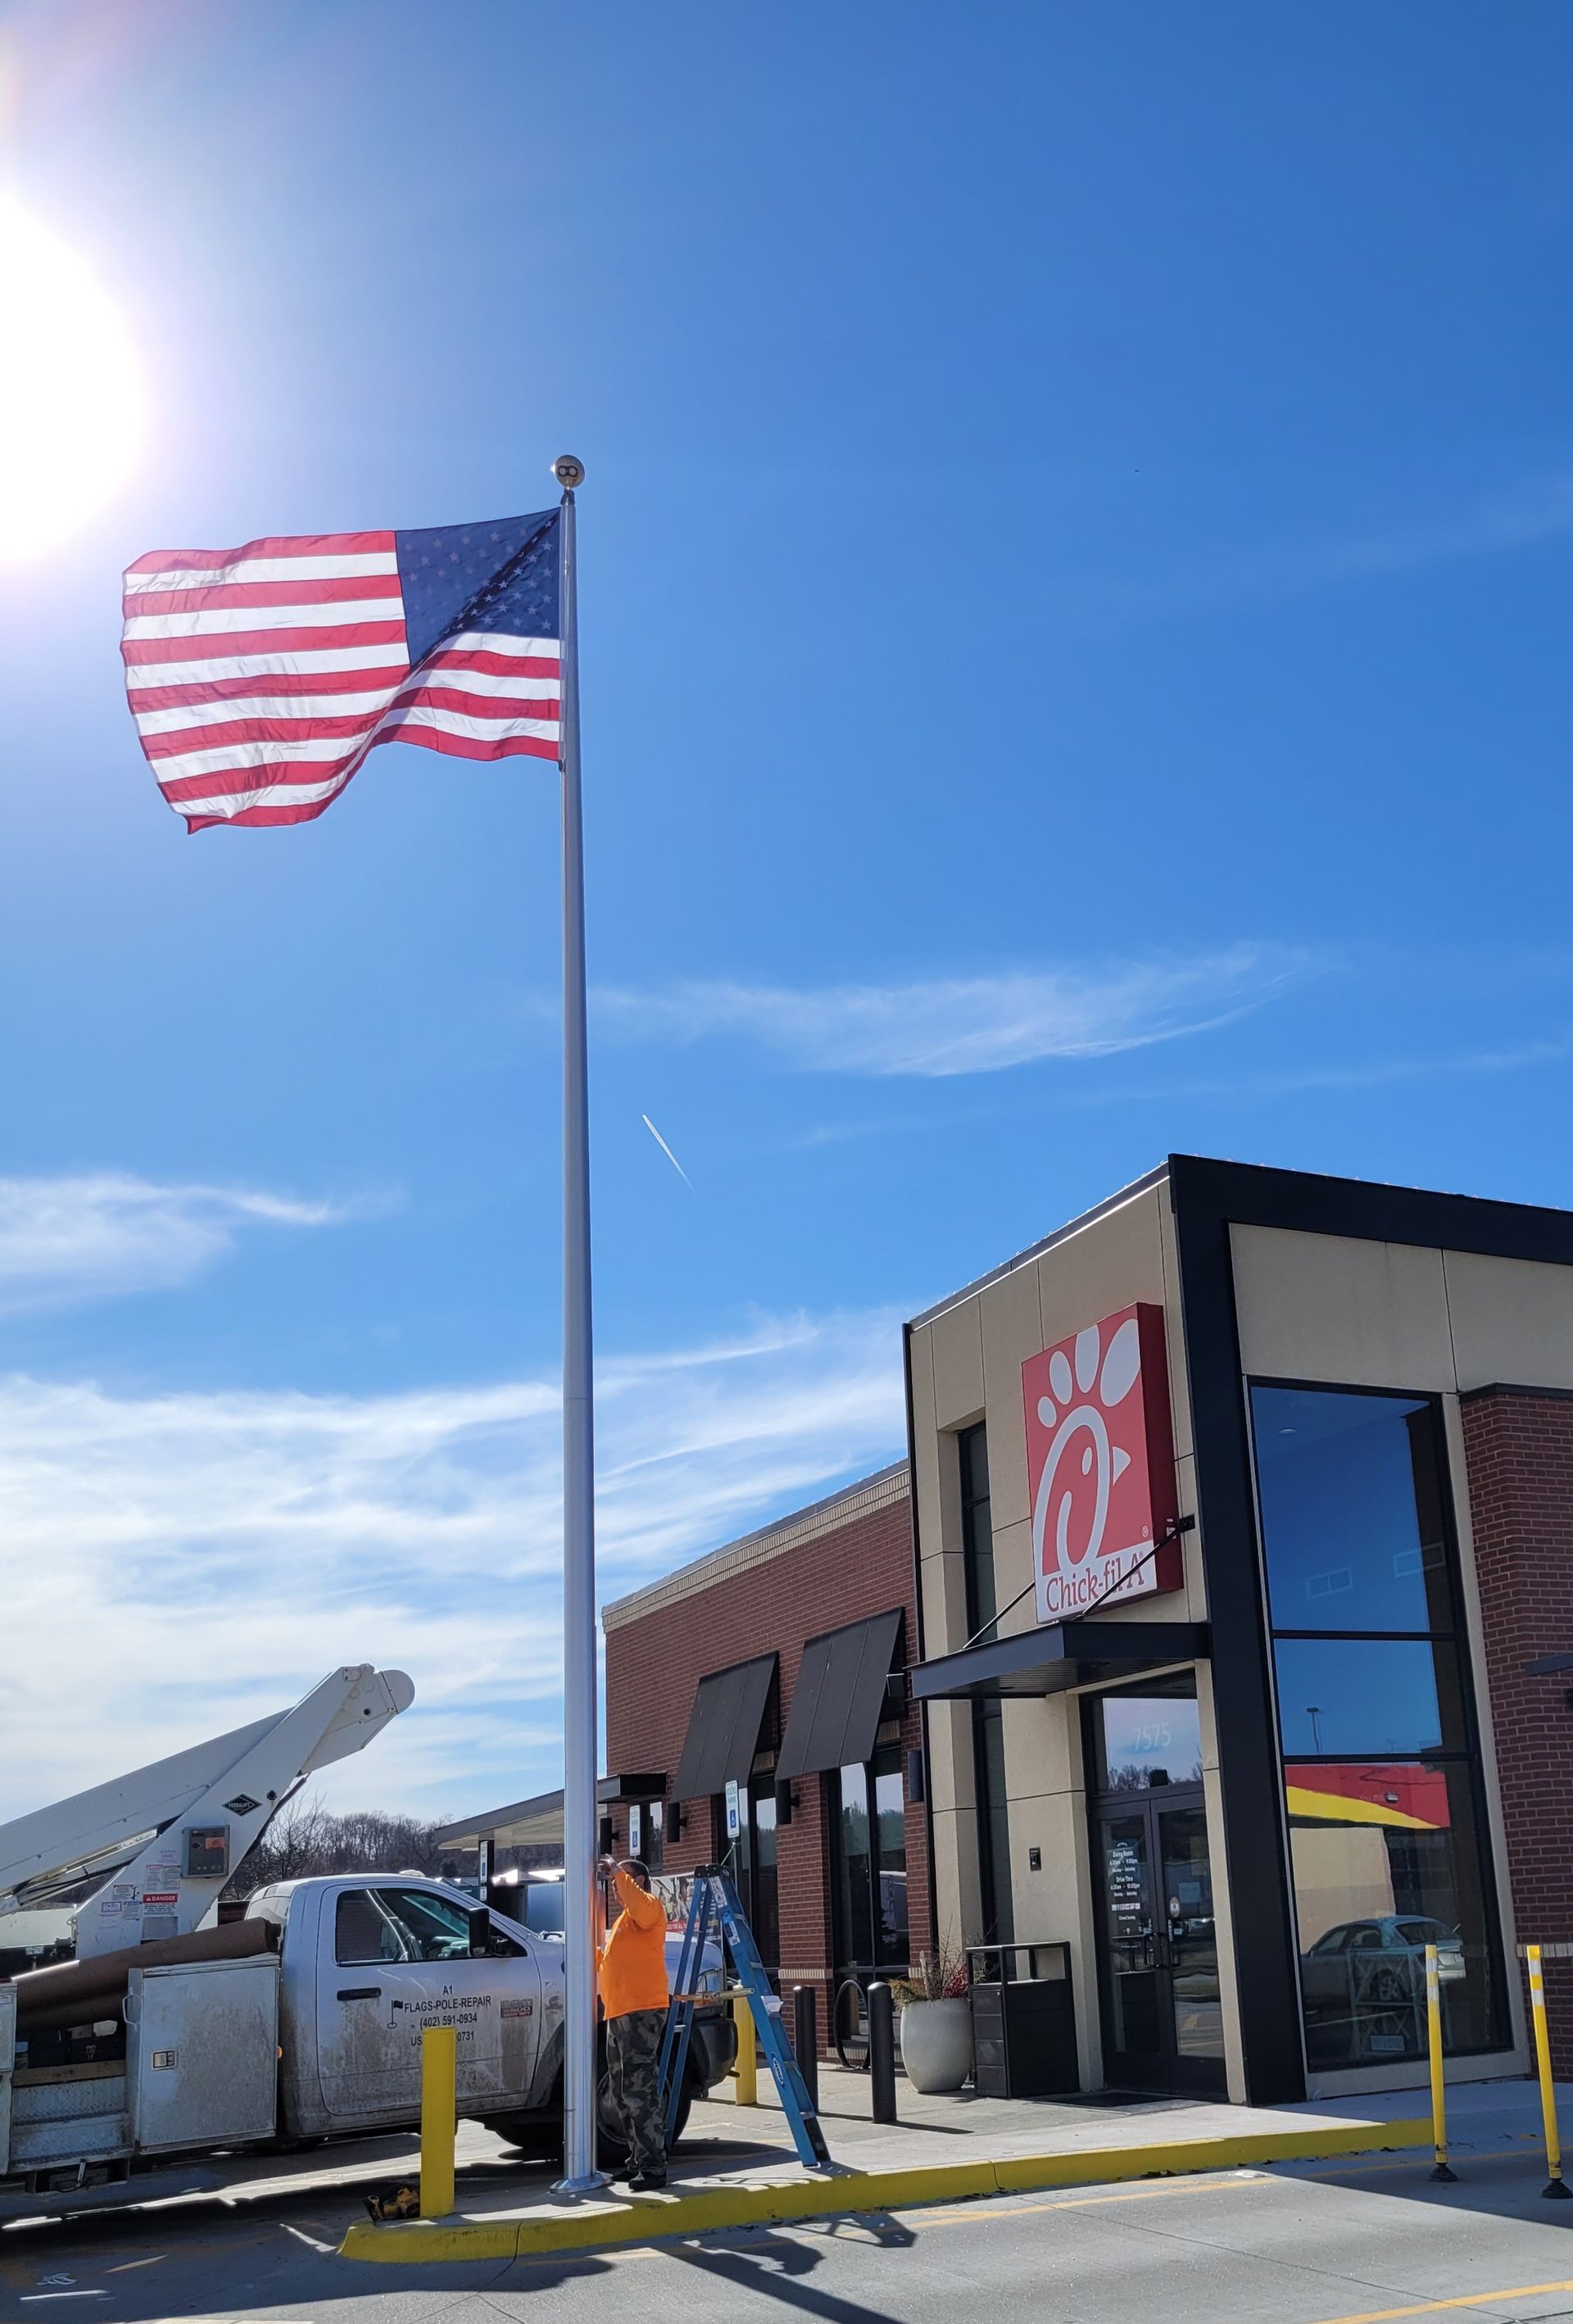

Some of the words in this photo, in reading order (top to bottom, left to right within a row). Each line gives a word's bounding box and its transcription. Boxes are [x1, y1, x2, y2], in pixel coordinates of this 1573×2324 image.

[1046, 1552, 1145, 1613] Chick-filA
[1133, 1722, 1172, 1752] 7575
[442, 1985, 453, 1995] A1
[404, 1995, 492, 2013] FLAGS-POLE-REPAIR
[442, 2013, 478, 2027] 591-0934
